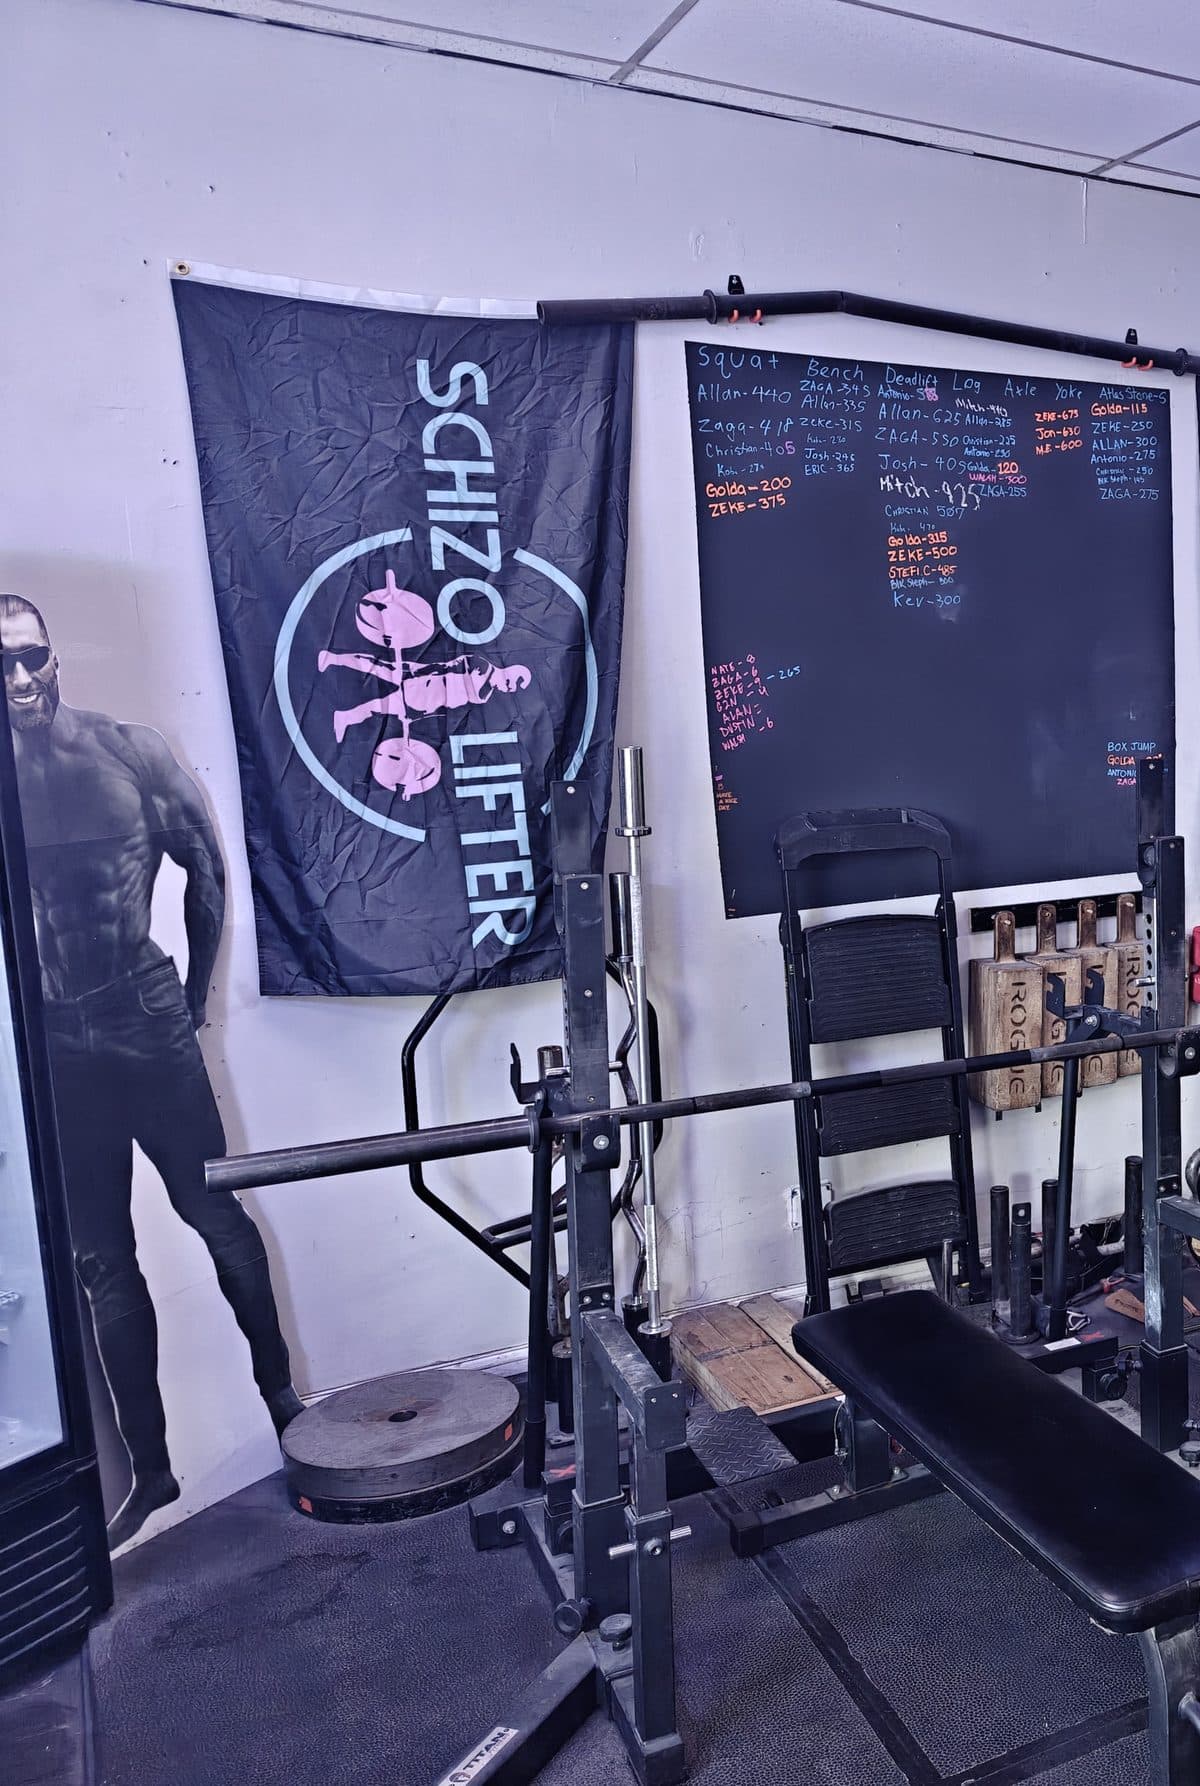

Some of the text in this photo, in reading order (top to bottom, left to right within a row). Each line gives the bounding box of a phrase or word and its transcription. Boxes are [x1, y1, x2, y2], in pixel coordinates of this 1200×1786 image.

[698, 346, 779, 379] Squat
[807, 358, 864, 381] Bench
[885, 366, 938, 389] Deadlift
[953, 372, 981, 393] Log
[1004, 378, 1037, 398] Axle
[1055, 383, 1083, 400] Yoke
[417, 359, 505, 645] SCHIZO
[1107, 742, 1156, 753] BOX JUMP
[449, 731, 536, 950] LIFTER
[462, 1731, 506, 1771] TITAN
